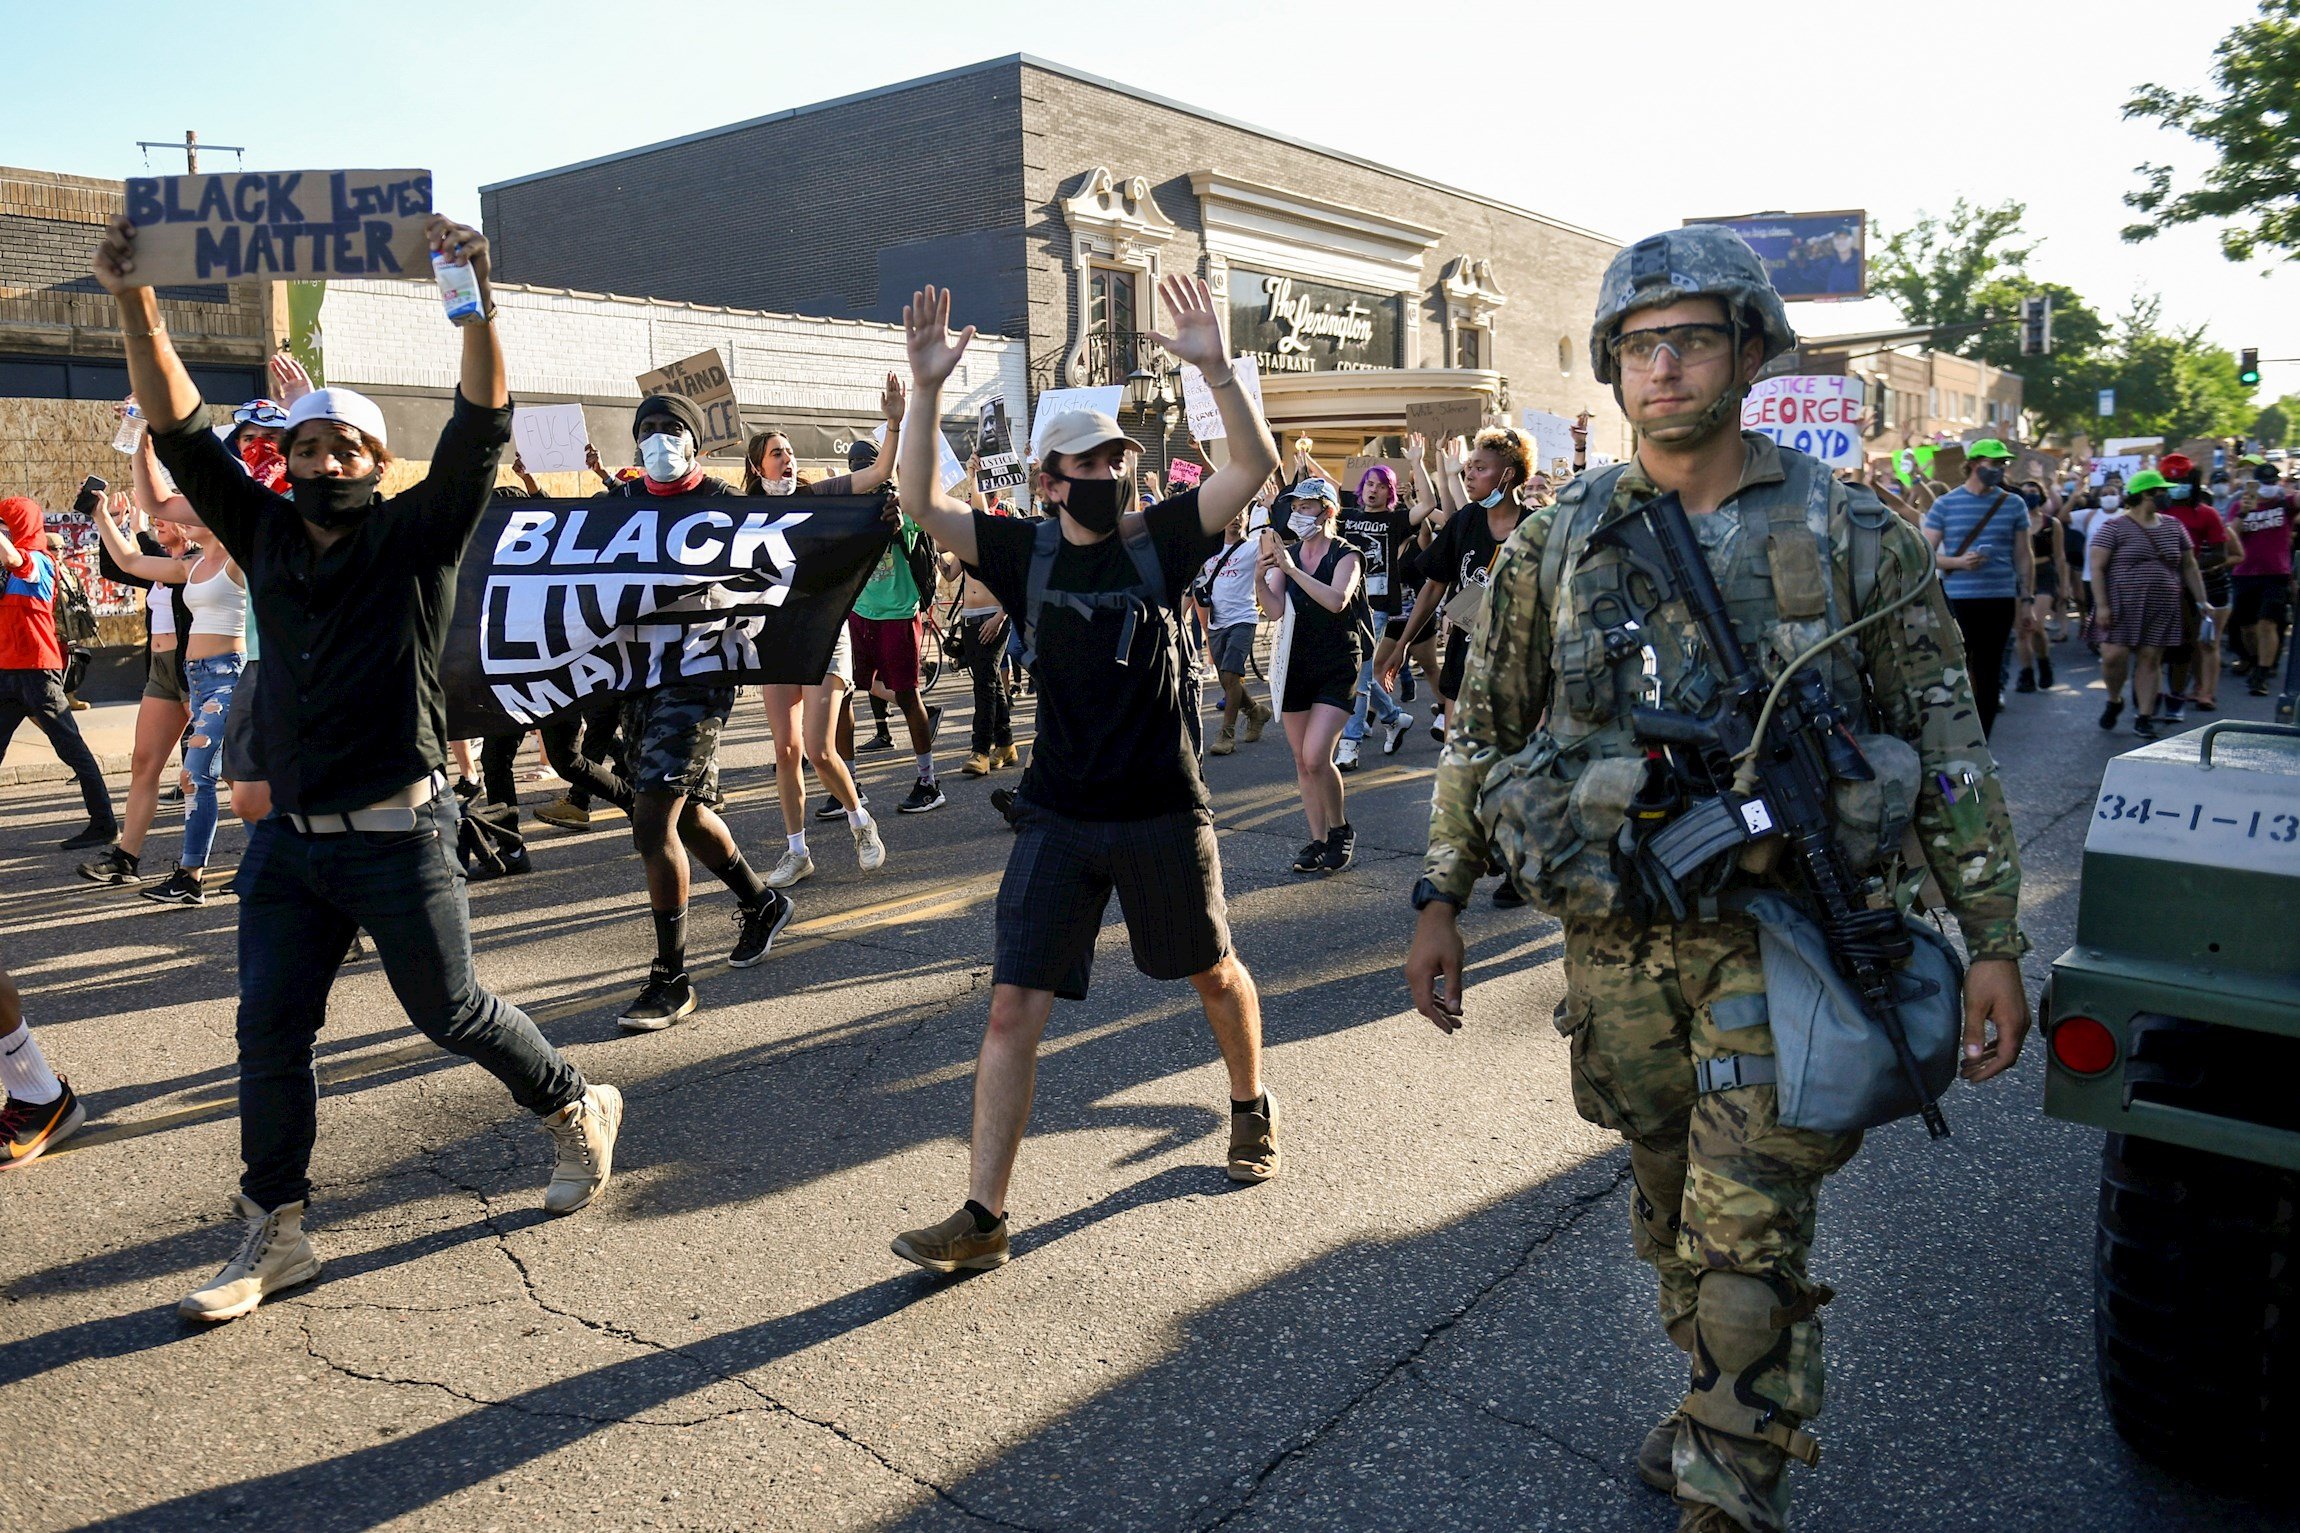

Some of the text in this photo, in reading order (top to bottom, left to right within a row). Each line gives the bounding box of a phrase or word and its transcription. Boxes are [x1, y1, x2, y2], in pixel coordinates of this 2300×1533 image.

[126, 171, 431, 227] BLACK LIVES
[195, 220, 403, 279] MATTER
[1266, 276, 1373, 353] The Lexington
[1828, 377, 1845, 395] 4
[1742, 397, 1862, 427] GEORGE
[523, 415, 582, 450] FUCK
[538, 451, 570, 469] 12
[993, 468, 1006, 476] FOR
[982, 472, 1023, 491] FLOYD
[492, 510, 814, 569] BLACK
[490, 615, 767, 725] MATTER
